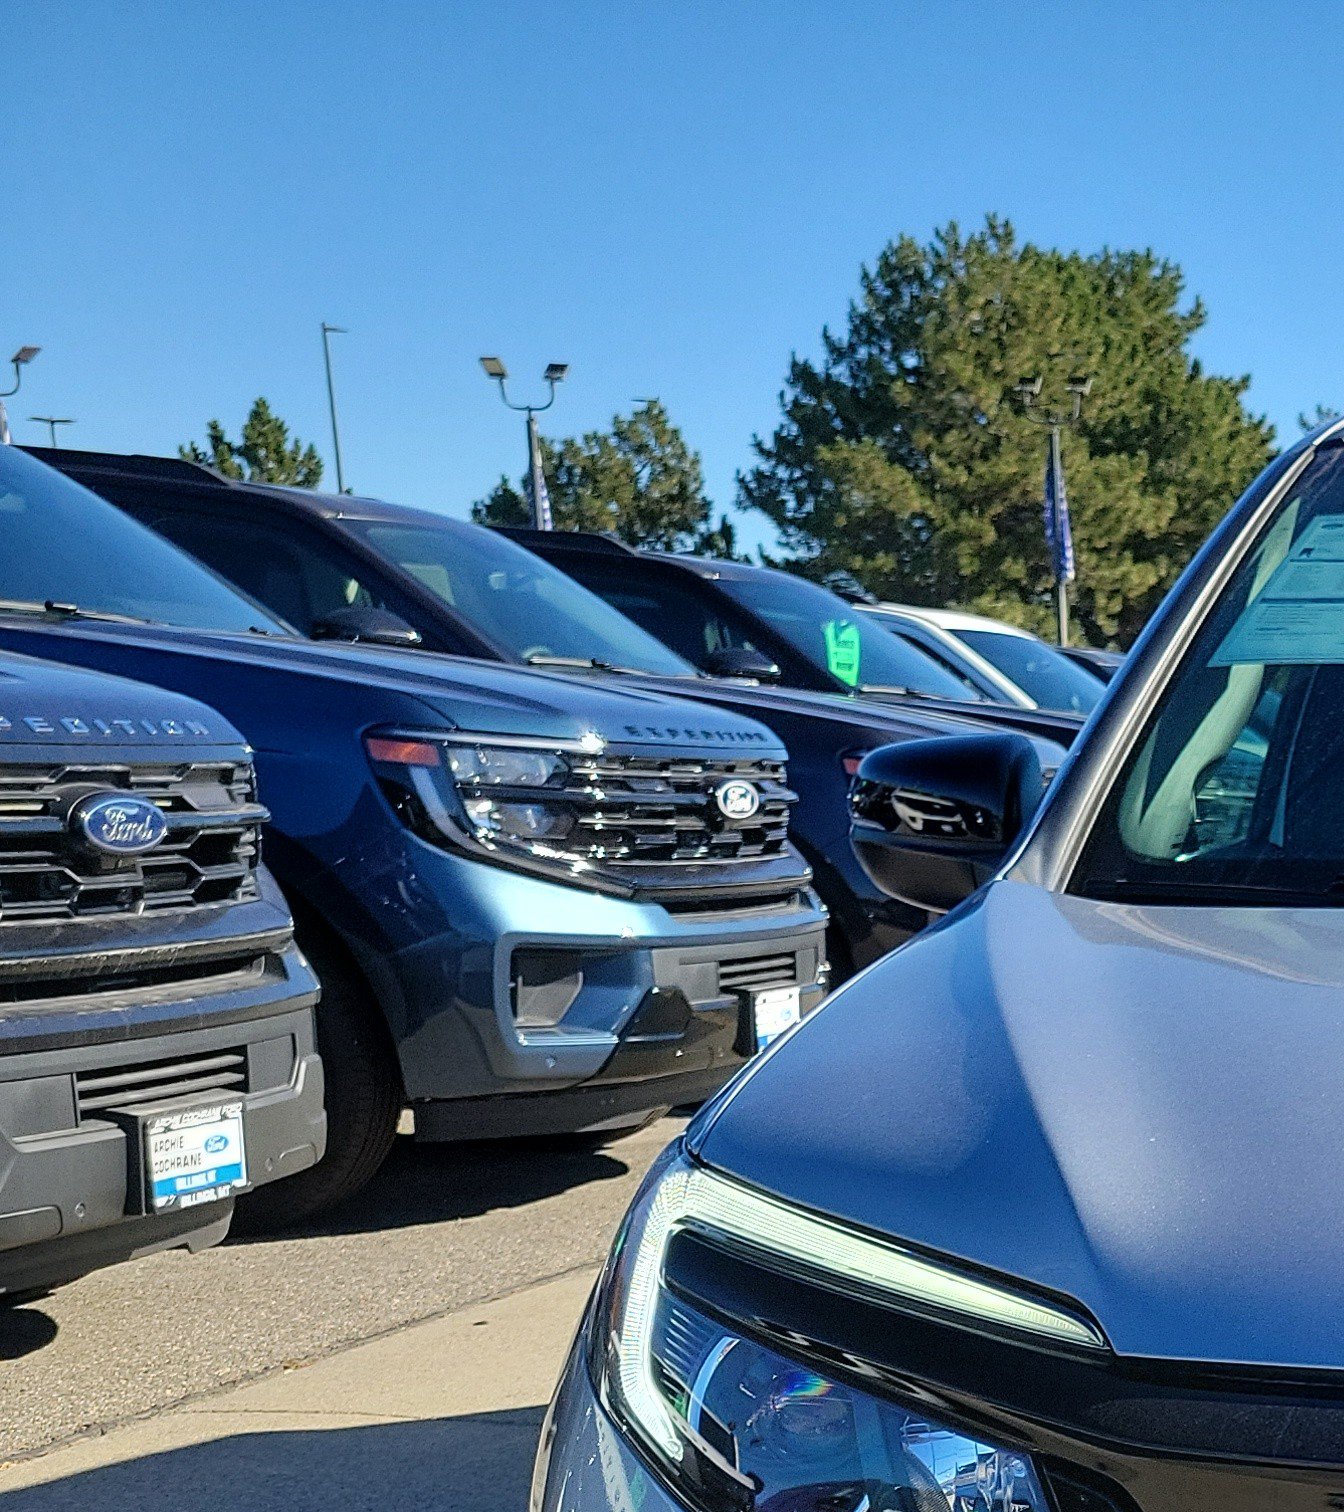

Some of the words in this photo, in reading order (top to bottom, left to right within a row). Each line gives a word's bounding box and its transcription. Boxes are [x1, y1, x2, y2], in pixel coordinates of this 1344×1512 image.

[102, 805, 153, 842] Ford
[154, 1135, 184, 1154] ARCHIE
[154, 1152, 202, 1175] COCHRANE
